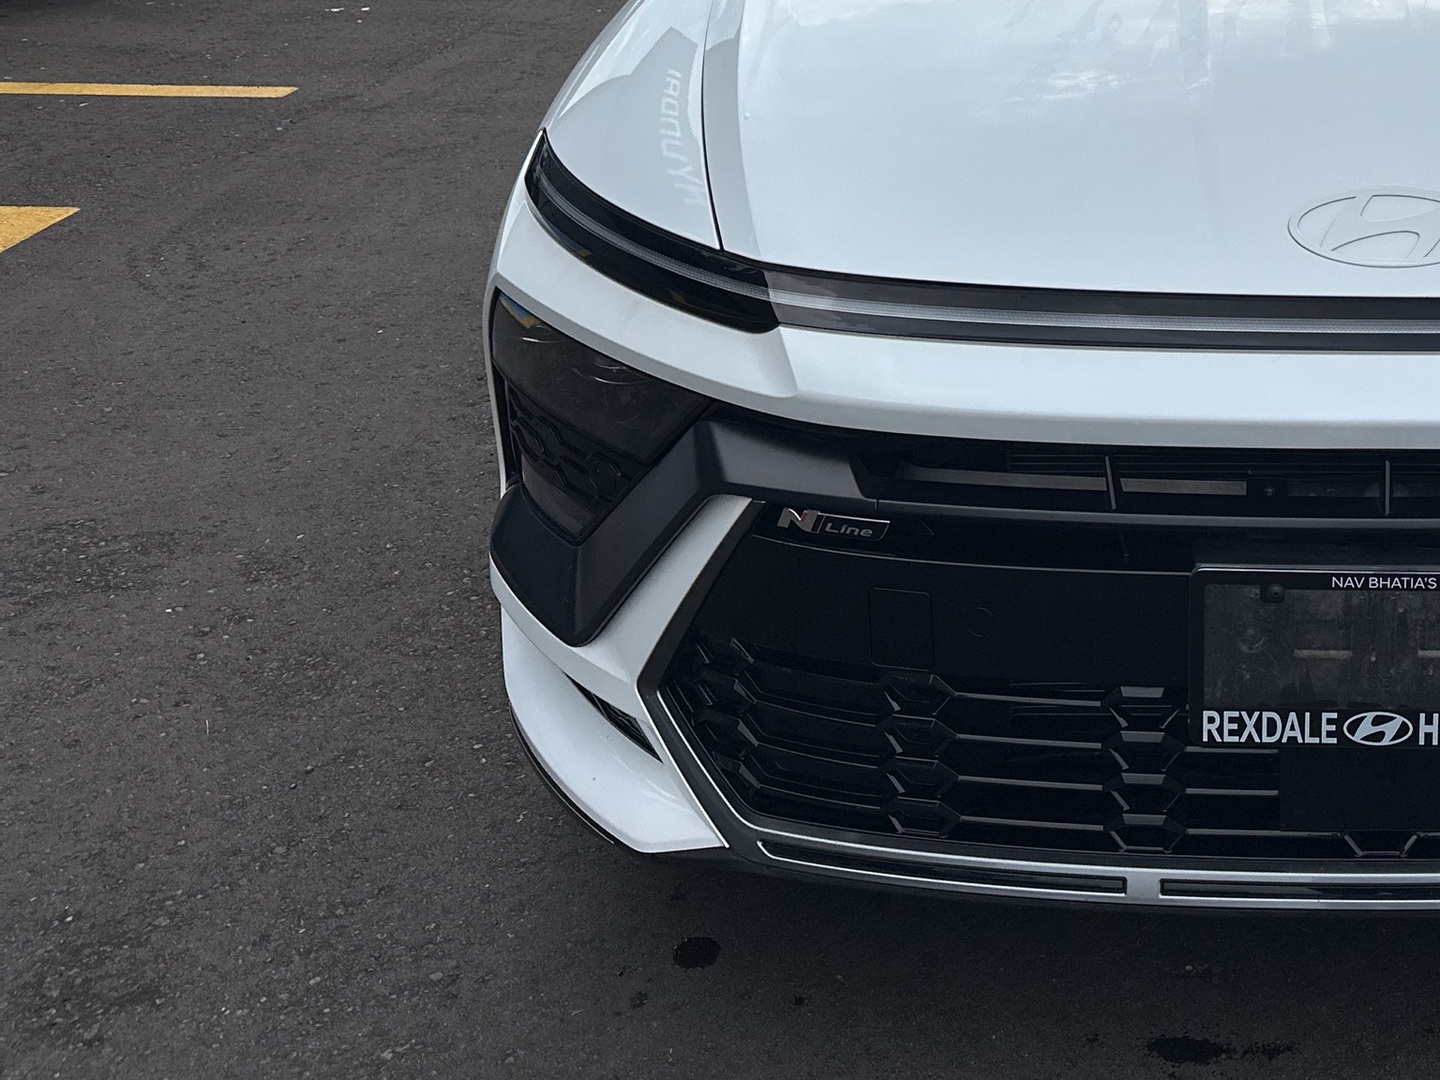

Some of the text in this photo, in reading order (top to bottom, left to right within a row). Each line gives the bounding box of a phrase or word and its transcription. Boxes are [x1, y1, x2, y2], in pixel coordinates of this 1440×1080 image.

[824, 522, 874, 538] Line
[1331, 575, 1438, 590] NAV BHATIA'S
[1201, 709, 1338, 745] REXDALE
